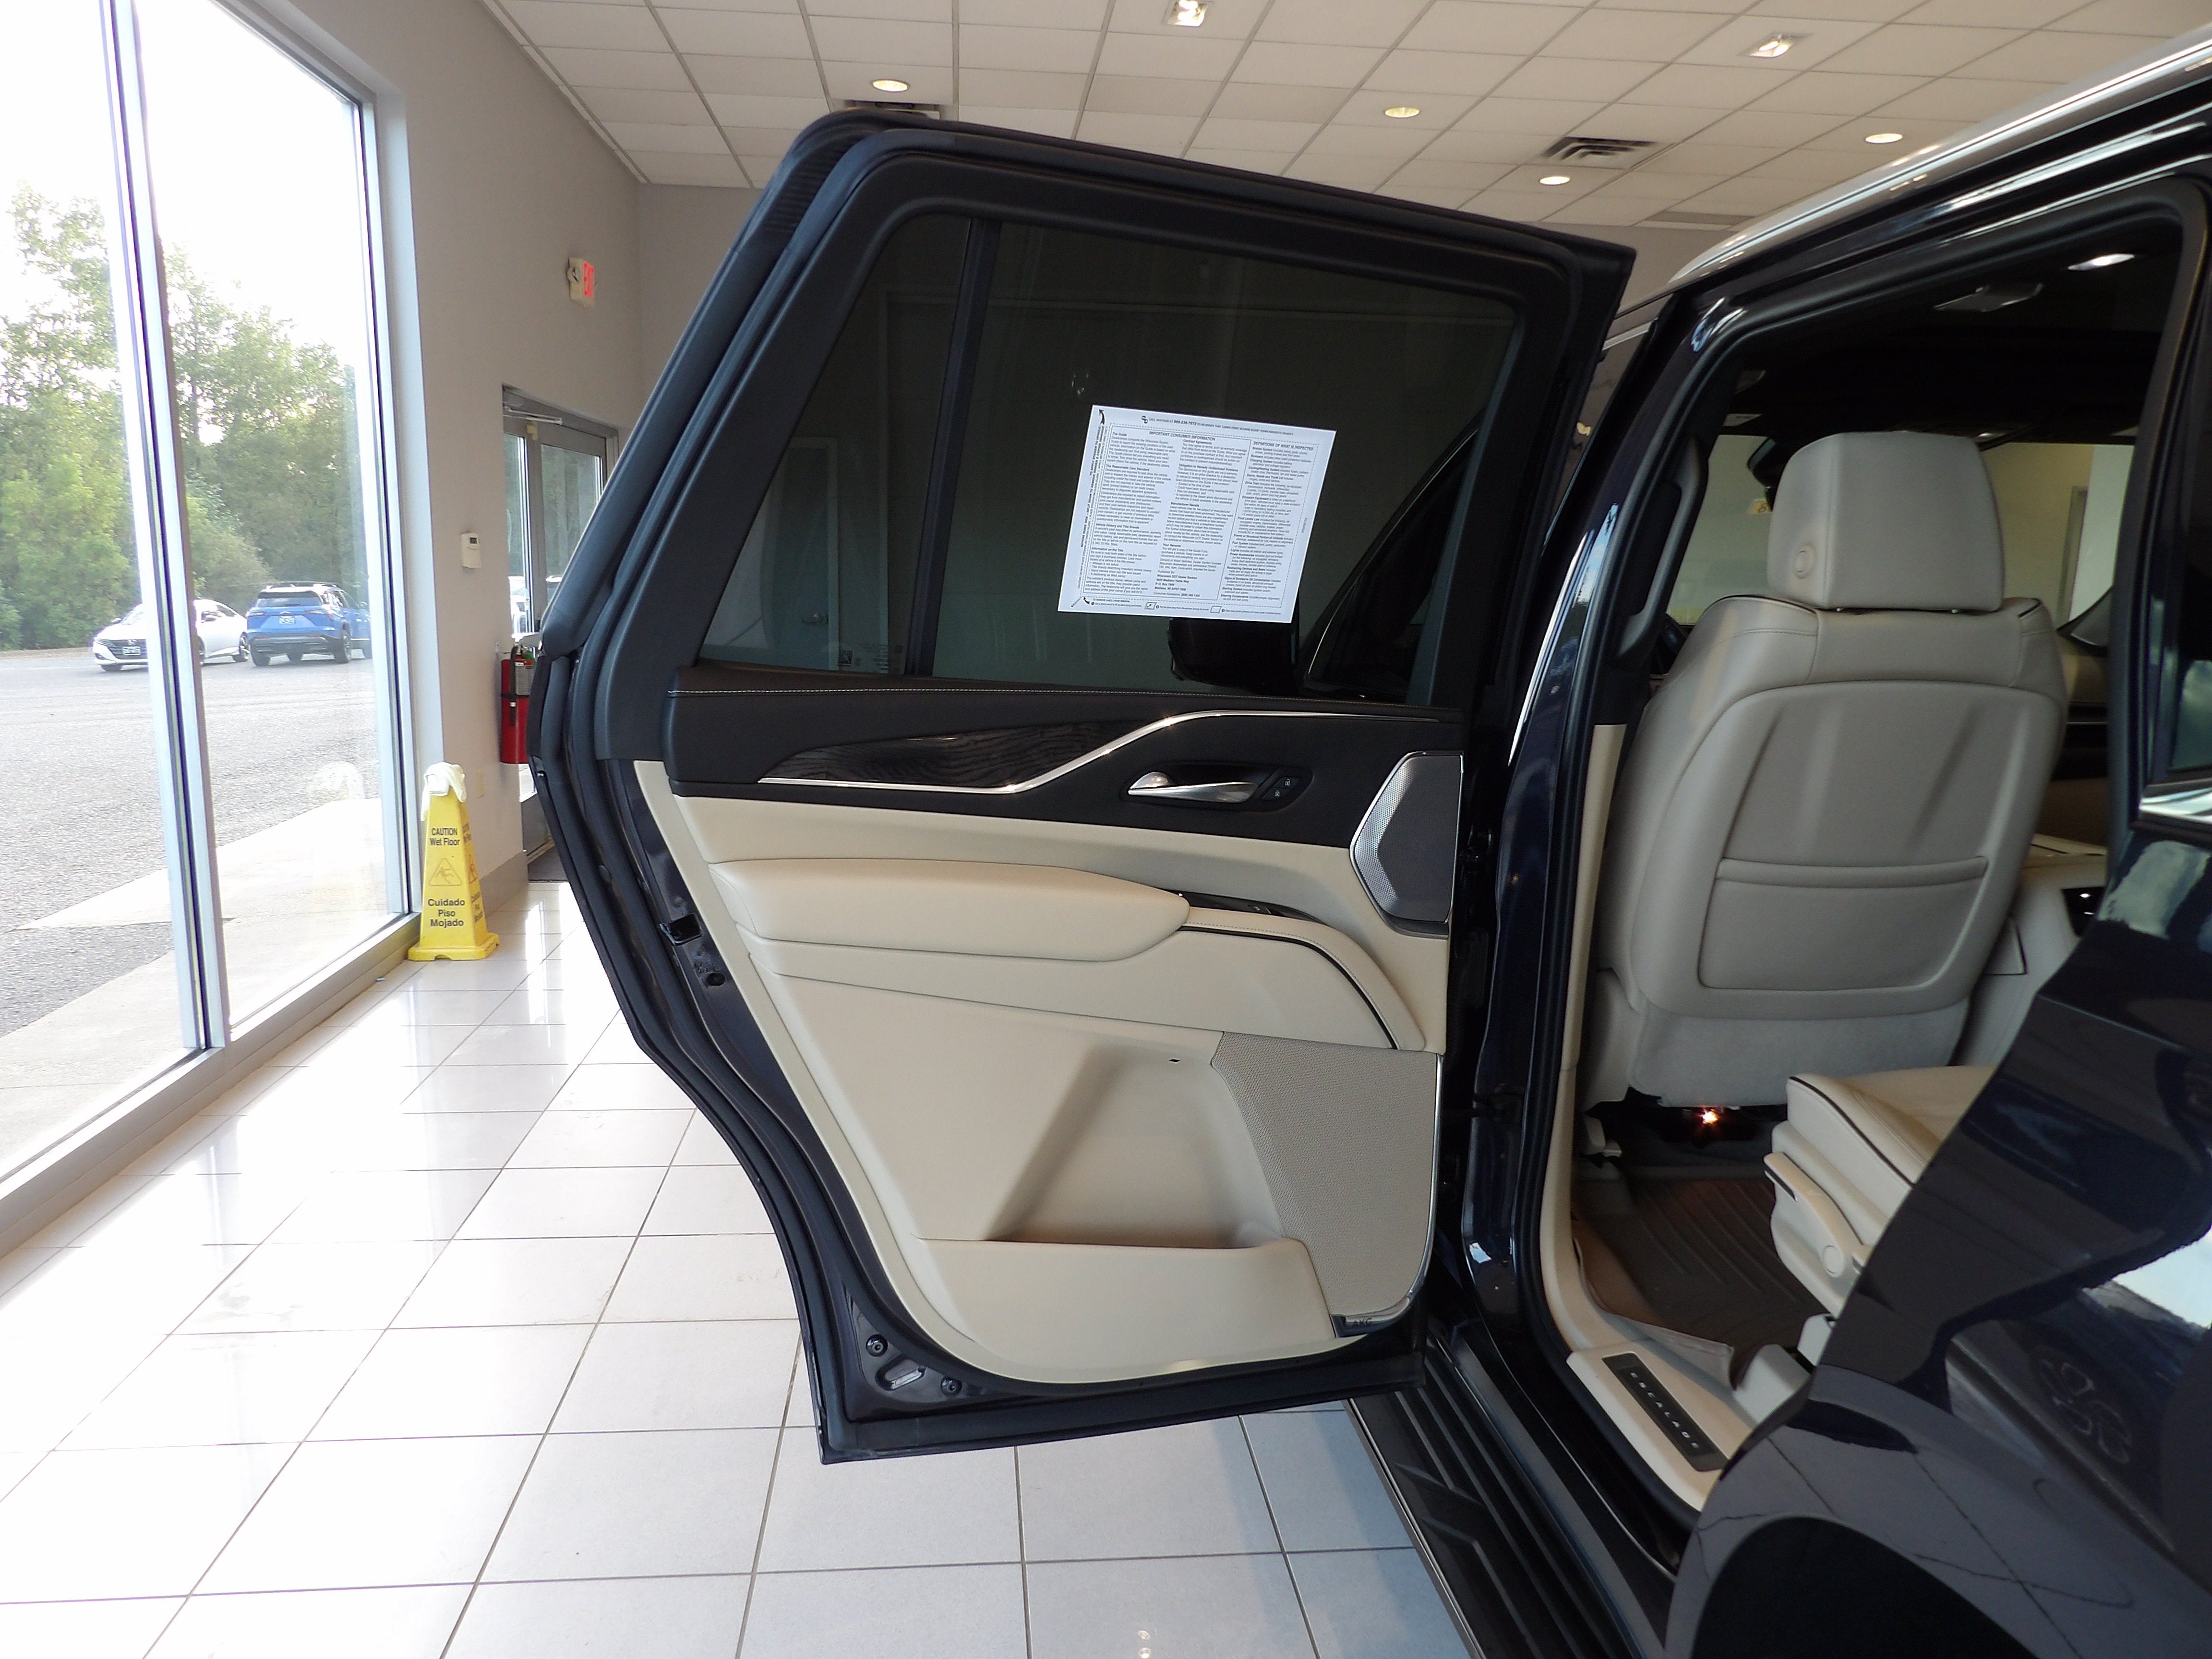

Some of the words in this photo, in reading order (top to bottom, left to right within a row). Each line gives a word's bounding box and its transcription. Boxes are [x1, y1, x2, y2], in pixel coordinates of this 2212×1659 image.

[444, 838, 460, 846] Floor
[430, 919, 464, 928] Mojado
[1352, 1318, 1373, 1327] AKG
[1630, 1371, 1701, 1449] ESCALADE
